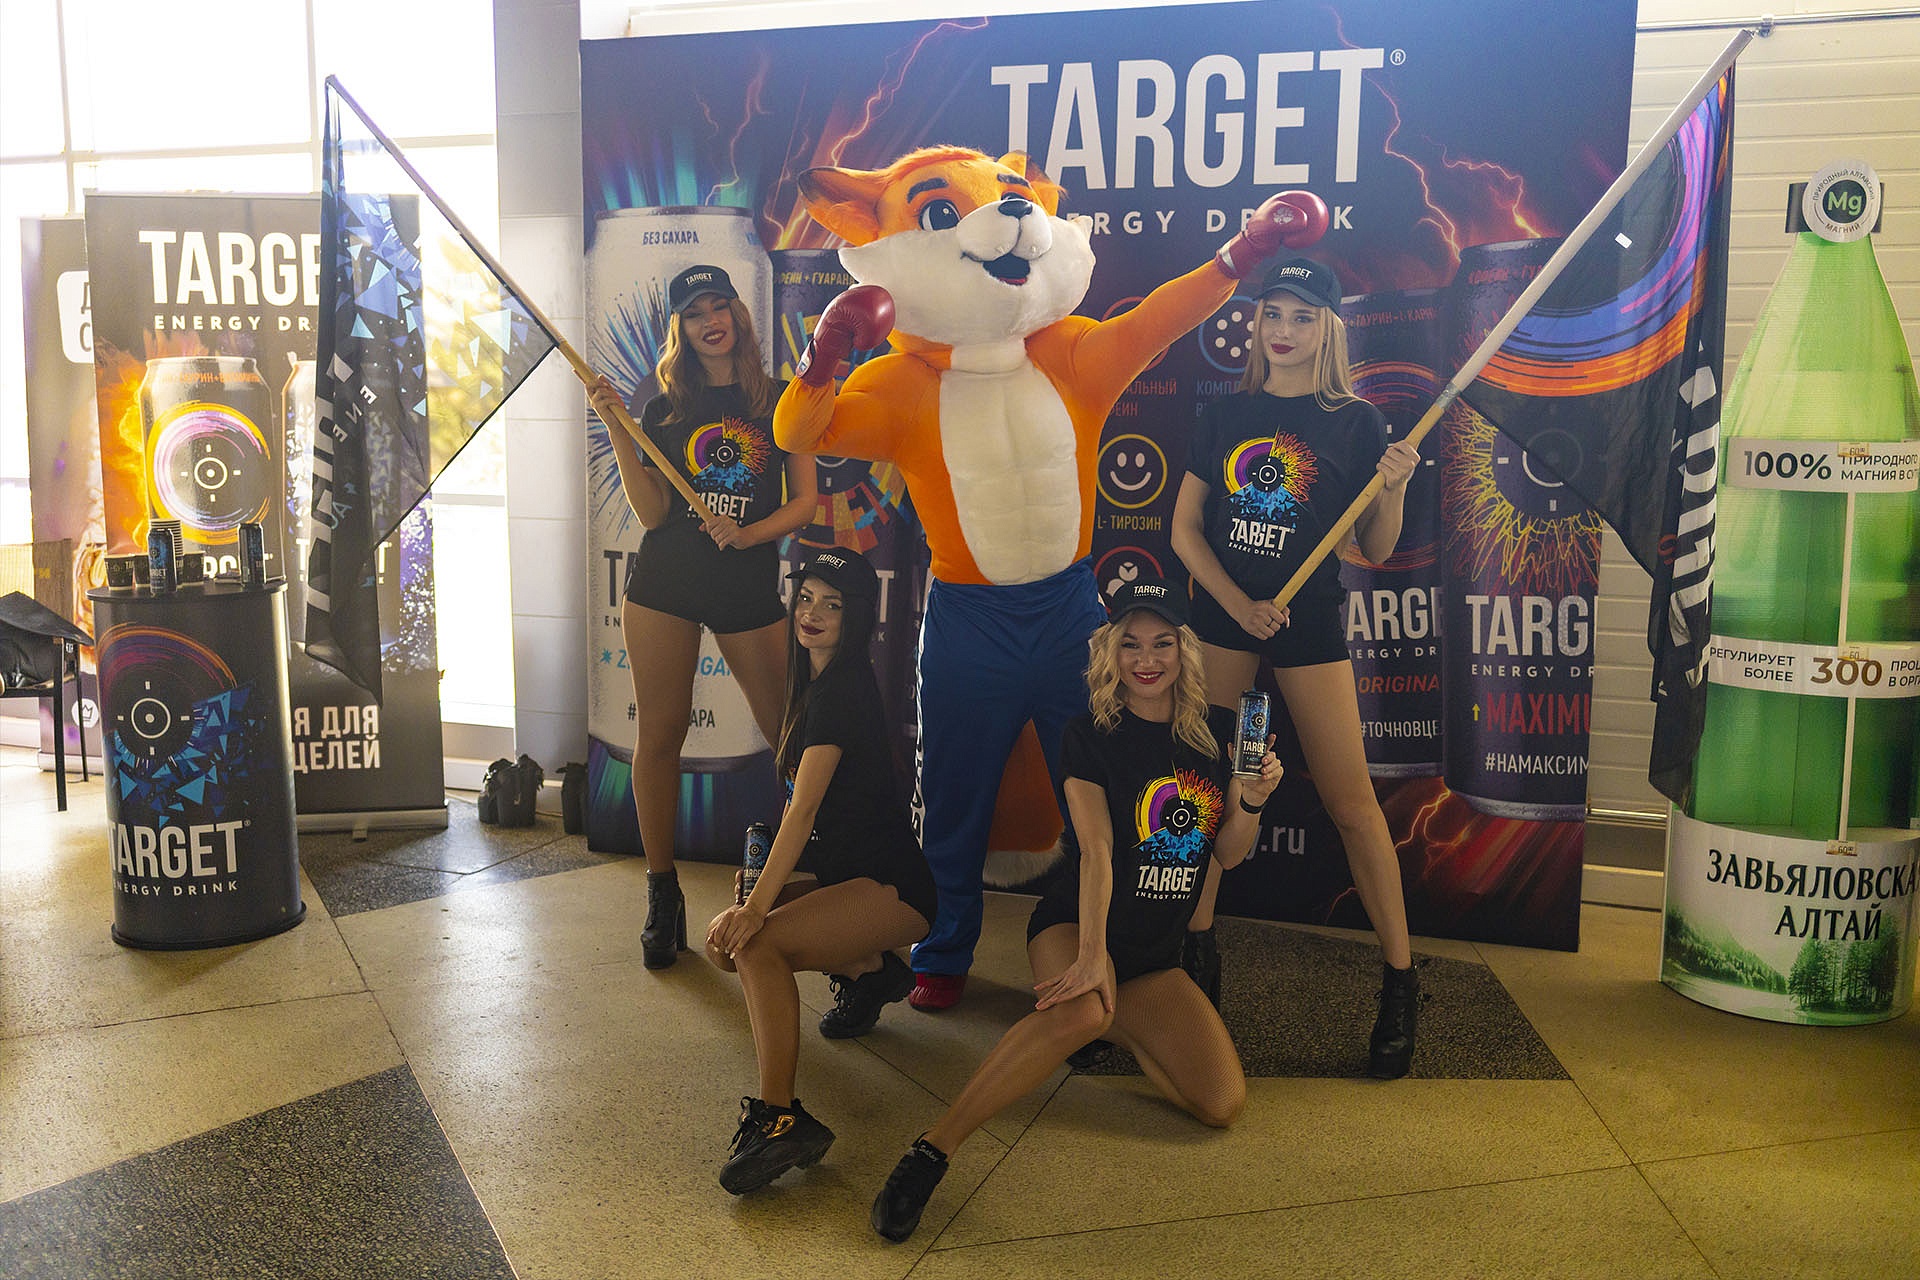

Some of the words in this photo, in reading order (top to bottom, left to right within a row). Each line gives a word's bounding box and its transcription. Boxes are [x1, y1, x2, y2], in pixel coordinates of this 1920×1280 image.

[991, 47, 1385, 190] TARGET
[1827, 191, 1863, 216] Mg
[1824, 222, 1861, 234] МАГНИЙ
[642, 230, 660, 246] БЕЗ
[662, 230, 700, 245] САХАРА
[138, 230, 321, 307] TARGE
[1280, 266, 1313, 279] TARGET
[685, 272, 713, 286] TARGET
[154, 314, 261, 332] ENERGY
[1743, 450, 1832, 481] 100%
[1841, 469, 1897, 481] МАГНИЯ
[1110, 515, 1162, 531] ТИРОЗИН
[816, 553, 847, 569] TARGET
[1133, 585, 1169, 596] TARGET
[1465, 594, 1599, 657] TARG
[1709, 646, 1796, 667] РЕГУЛИРУЕТ
[1471, 663, 1554, 678] ENERGY
[1744, 667, 1794, 682] БОЛЕЕ
[1810, 657, 1883, 686] 300
[321, 704, 379, 739] ДЛЯ
[292, 734, 381, 774] ЦЕЛЕЙ
[108, 820, 243, 879] TARGET
[173, 880, 238, 897] DRINK
[1135, 891, 1169, 900] ENERGY
[1774, 903, 1882, 941] АЛТАЙ
